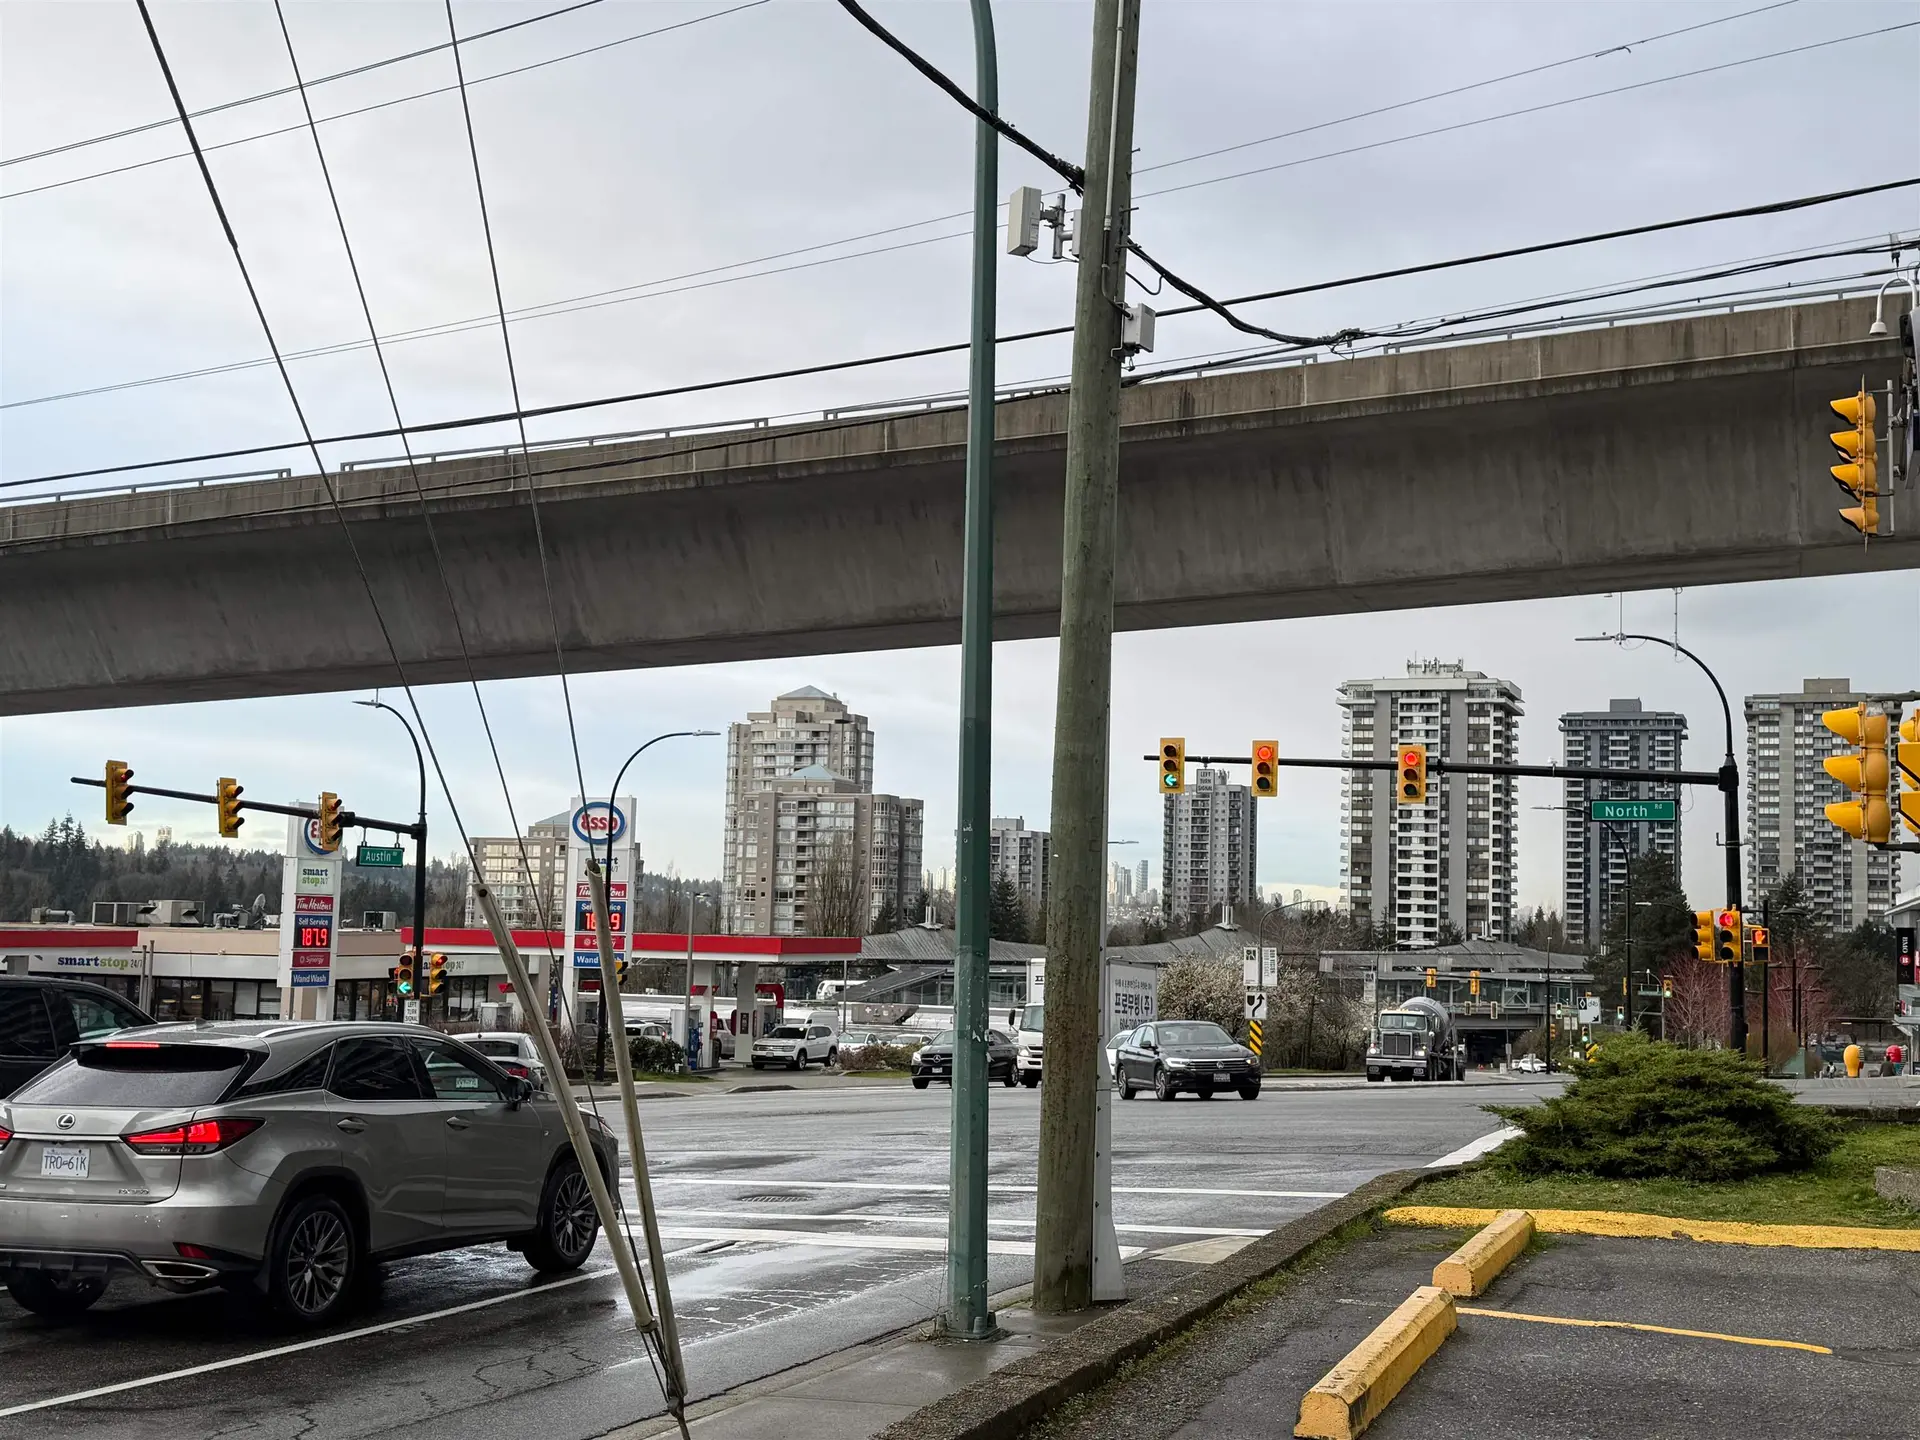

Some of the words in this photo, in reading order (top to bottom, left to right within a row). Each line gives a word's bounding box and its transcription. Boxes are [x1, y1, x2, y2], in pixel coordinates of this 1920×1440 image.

[1605, 805, 1648, 817] North
[365, 851, 391, 862] Austin
[302, 868, 328, 876] smart
[302, 876, 320, 887] stop
[297, 897, 308, 909] Tim
[309, 898, 332, 910] Hortons
[298, 917, 308, 926] Self
[309, 918, 328, 926] Service
[306, 956, 324, 964] Synergy
[293, 974, 310, 983] Wand
[311, 974, 327, 983] Wash
